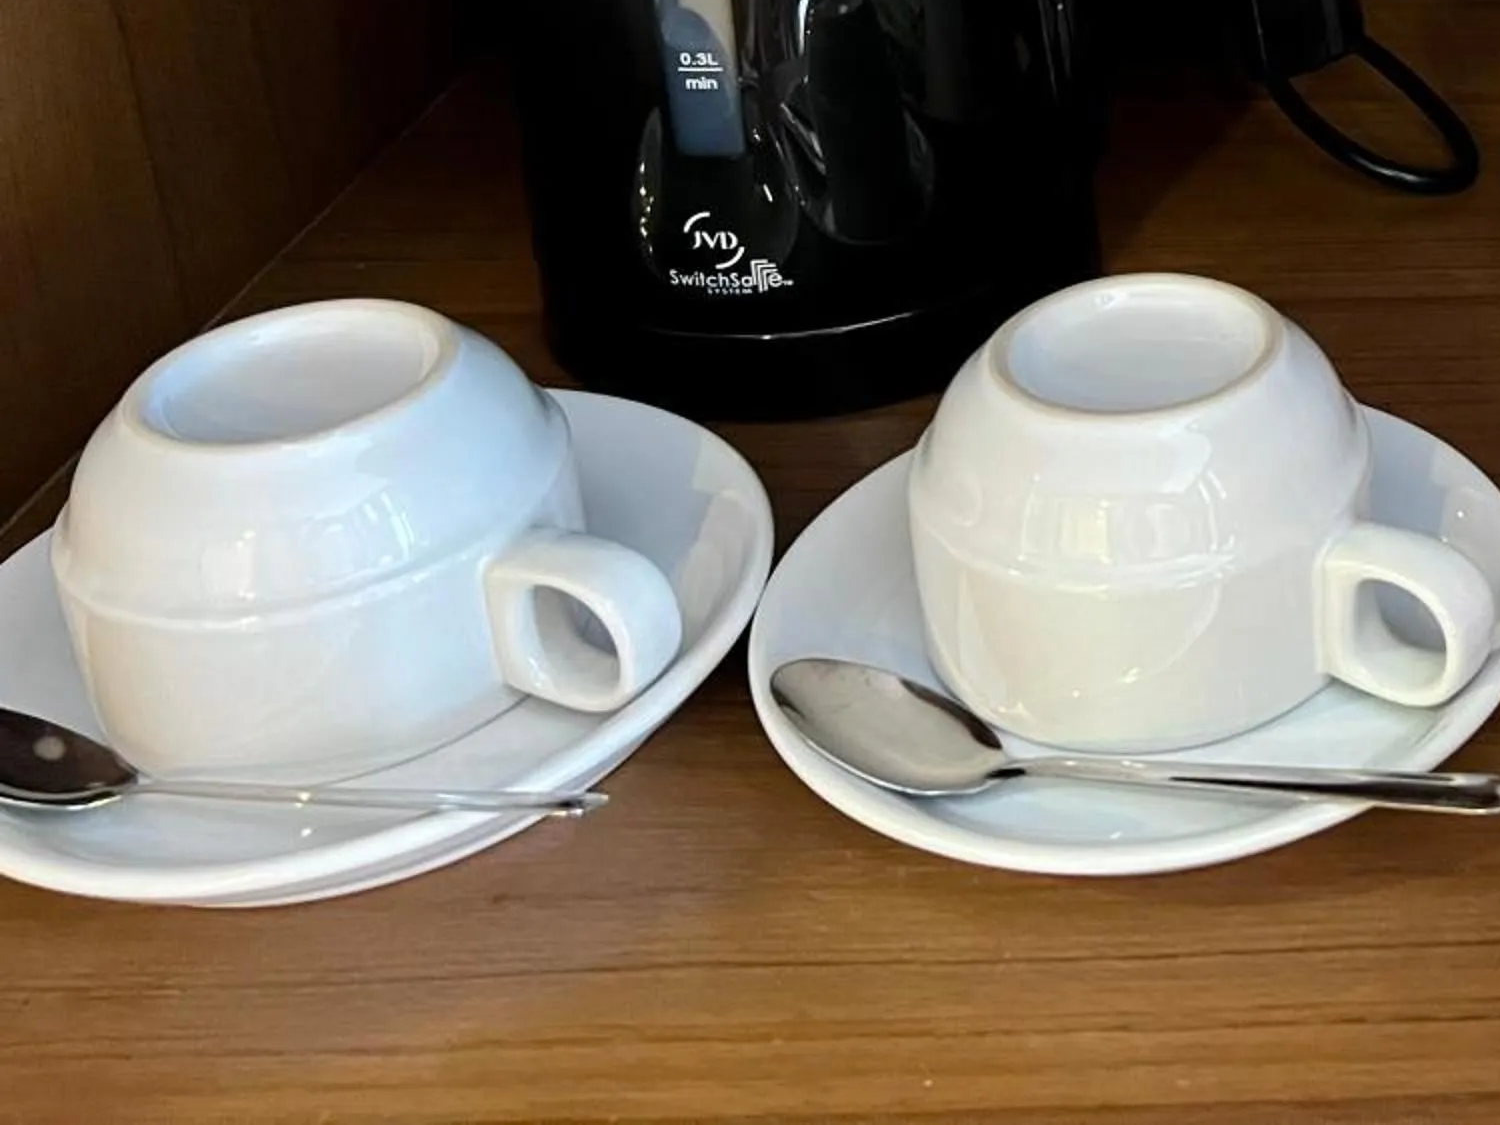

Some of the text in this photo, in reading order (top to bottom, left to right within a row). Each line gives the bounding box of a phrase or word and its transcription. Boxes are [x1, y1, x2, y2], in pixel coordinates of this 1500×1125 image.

[680, 52, 719, 66] 0.3L
[685, 76, 719, 90] min
[692, 231, 738, 250] JVD
